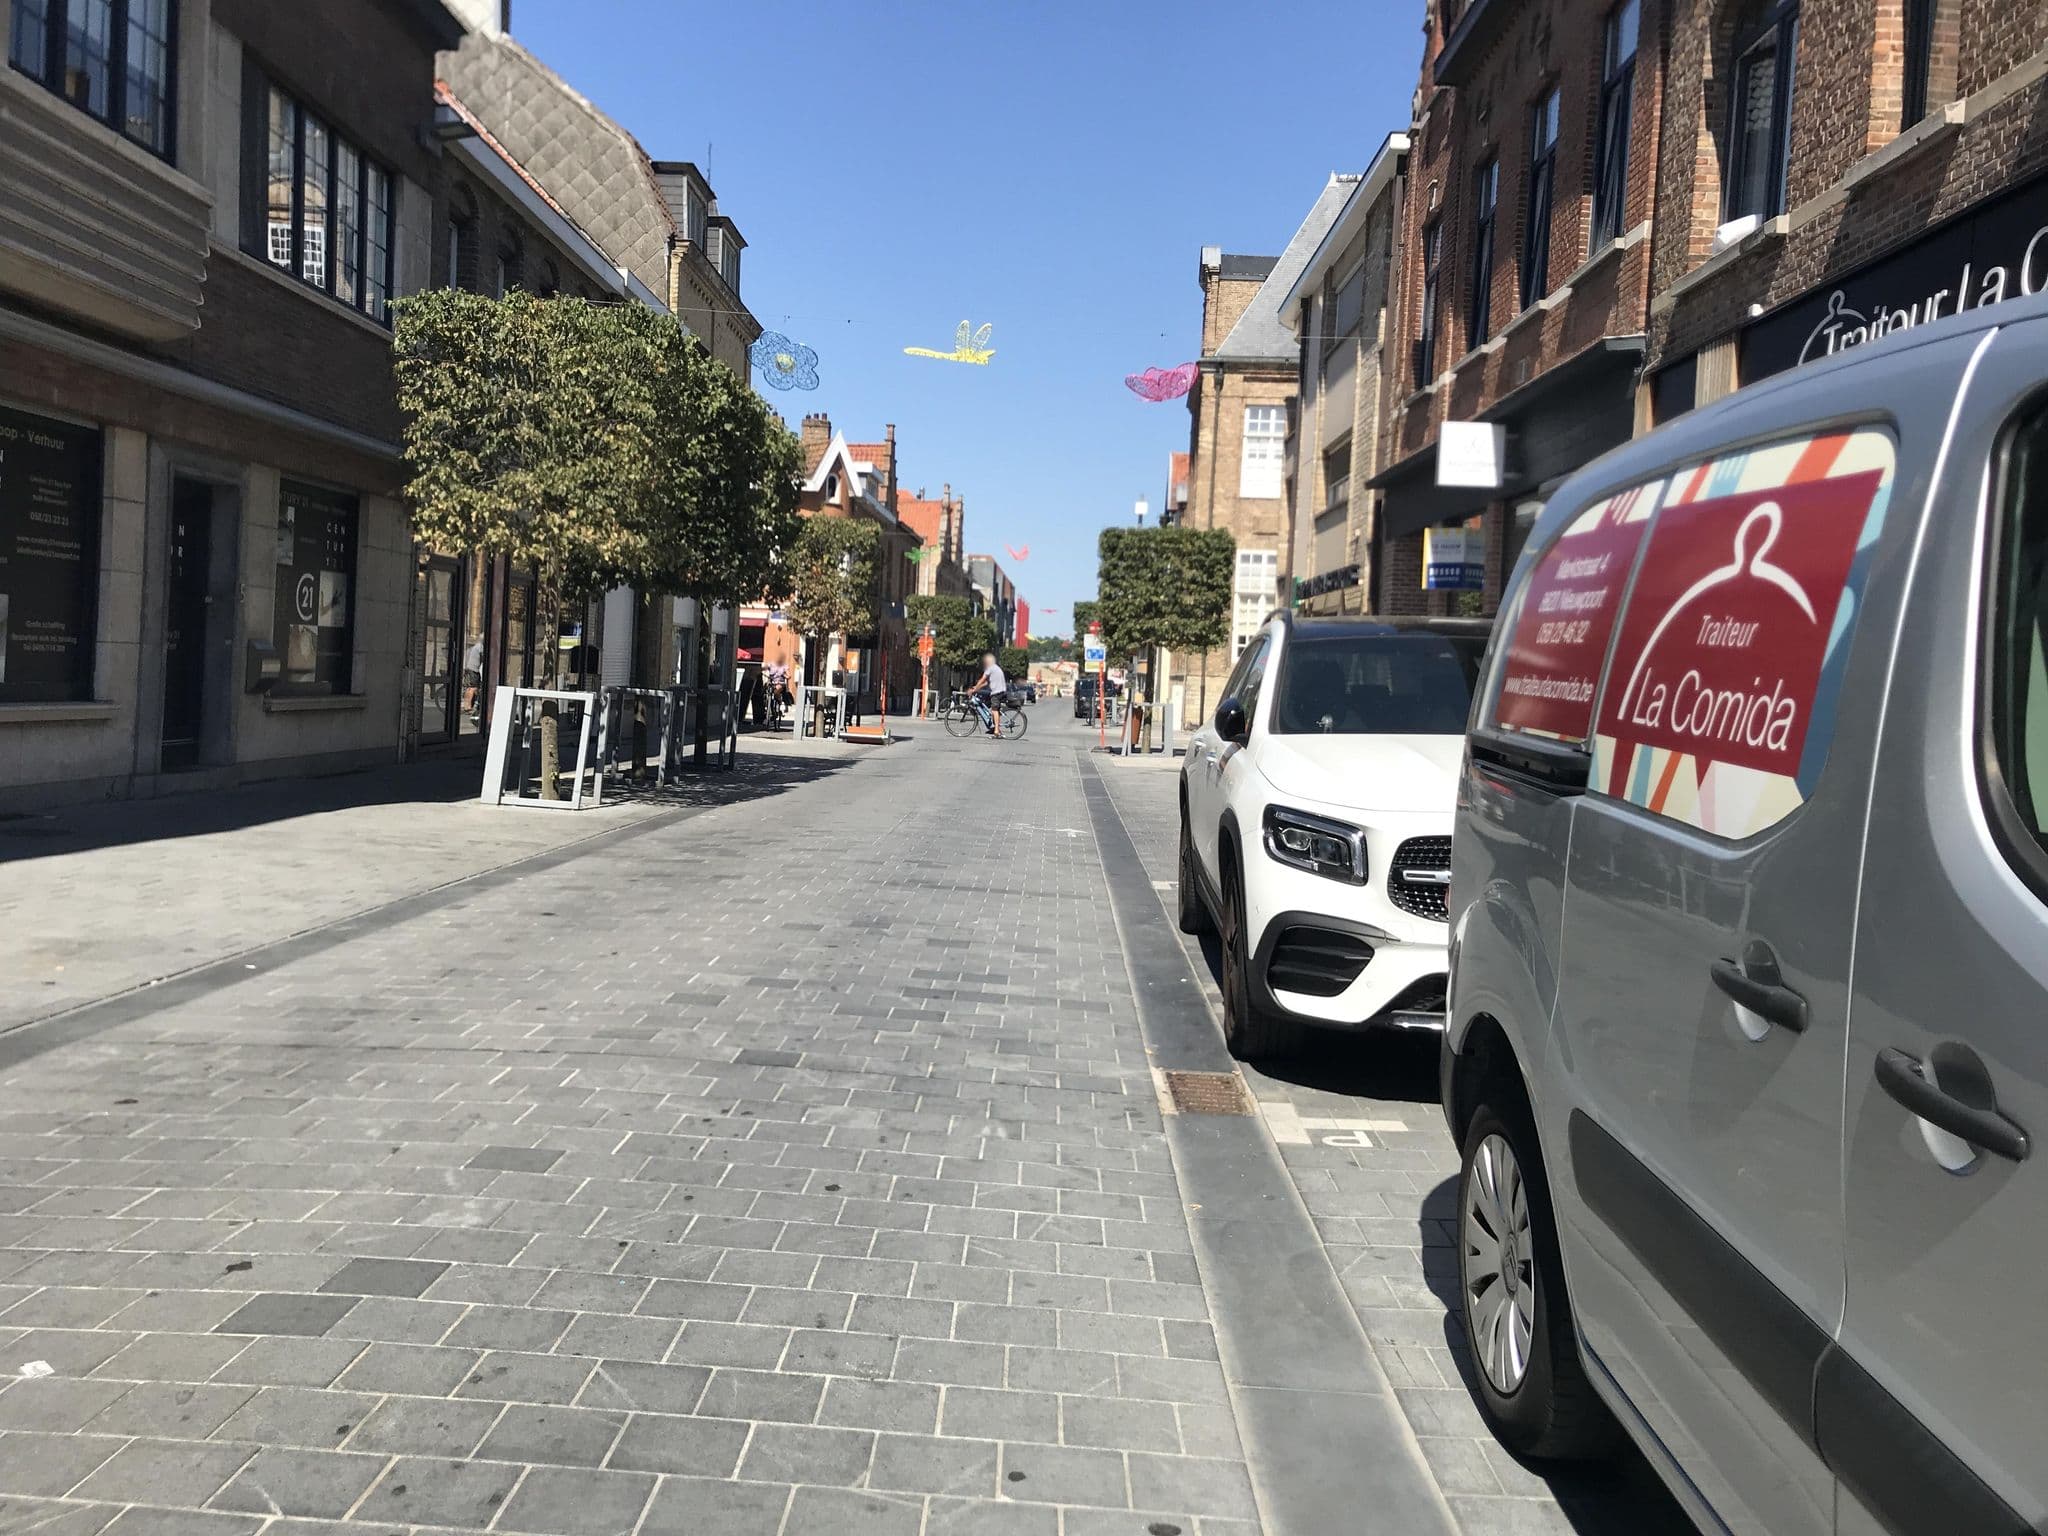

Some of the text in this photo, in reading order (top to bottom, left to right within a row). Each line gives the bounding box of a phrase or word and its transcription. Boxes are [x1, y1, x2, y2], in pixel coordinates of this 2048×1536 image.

[27, 430, 65, 450] Verhuur
[1600, 551, 1613, 574] 4
[1696, 613, 1759, 649] Traiteur
[1633, 667, 1797, 751] La Comida
